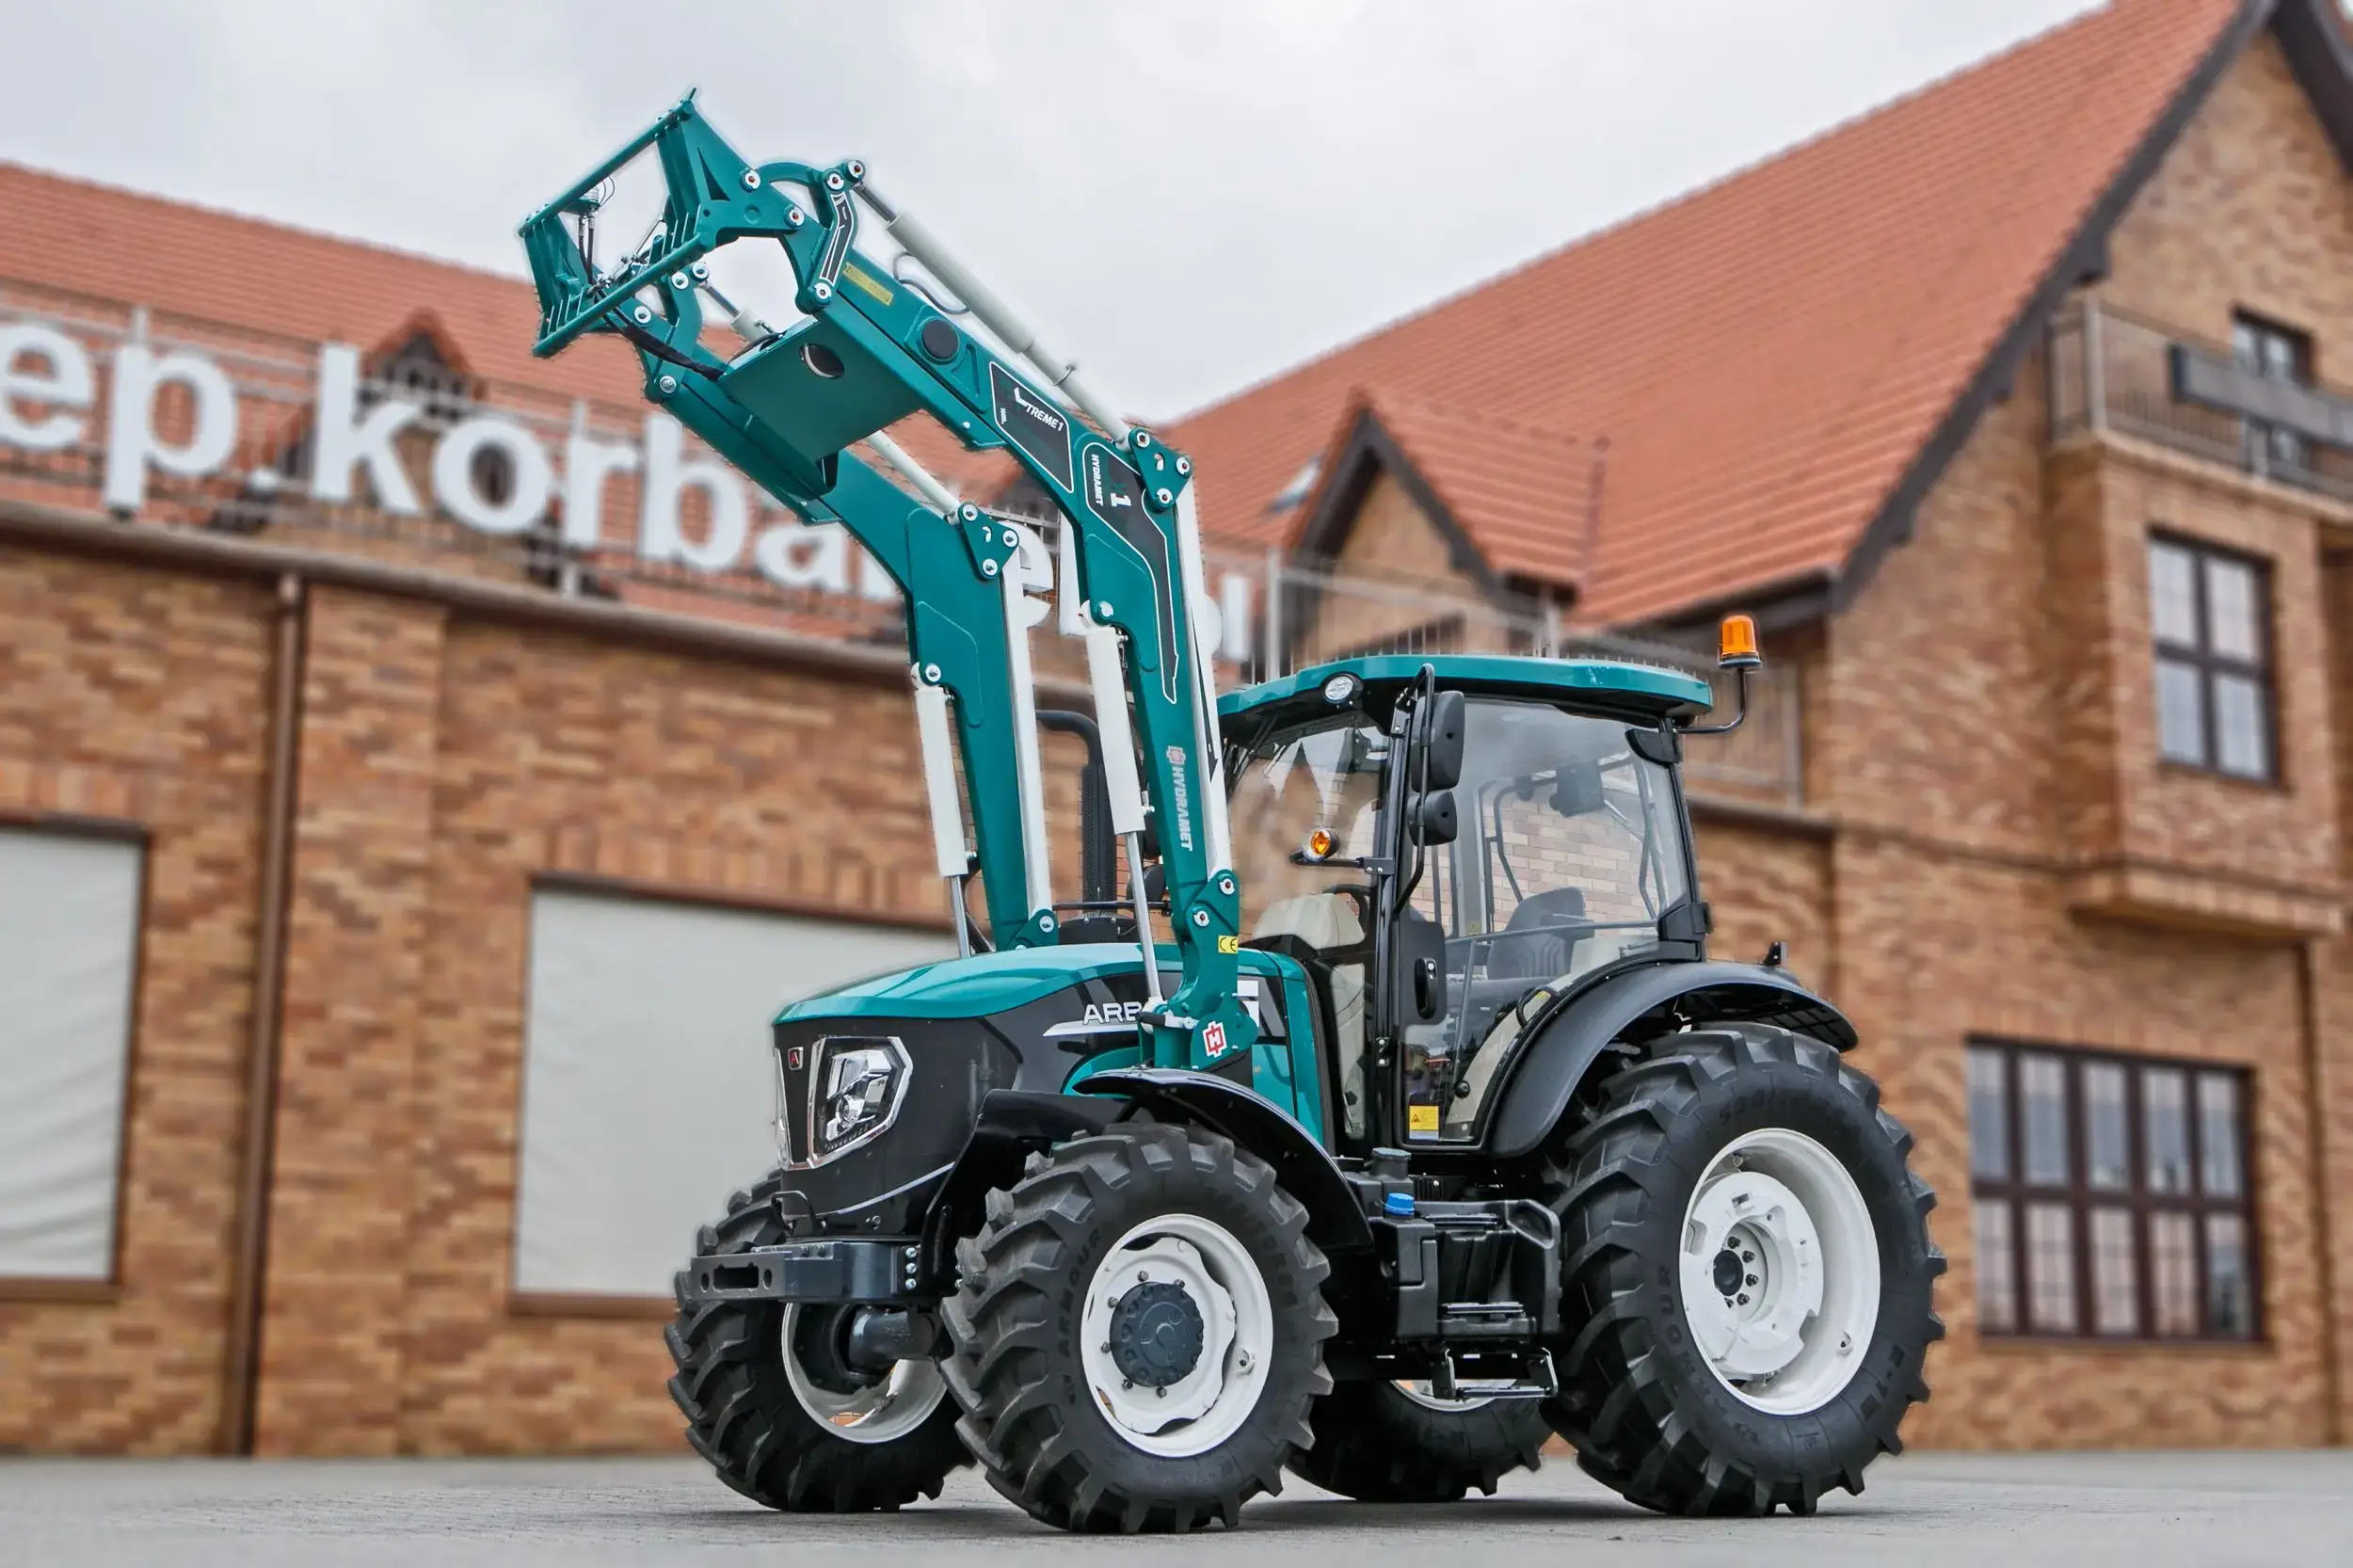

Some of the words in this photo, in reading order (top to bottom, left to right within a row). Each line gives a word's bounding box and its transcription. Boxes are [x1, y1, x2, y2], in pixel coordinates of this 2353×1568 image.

[1091, 454, 1104, 506] HYDRAMET
[1172, 766, 1193, 852] HYDRAMET
[1219, 936, 1237, 952] CE
[1083, 1001, 1143, 1025] ARB
